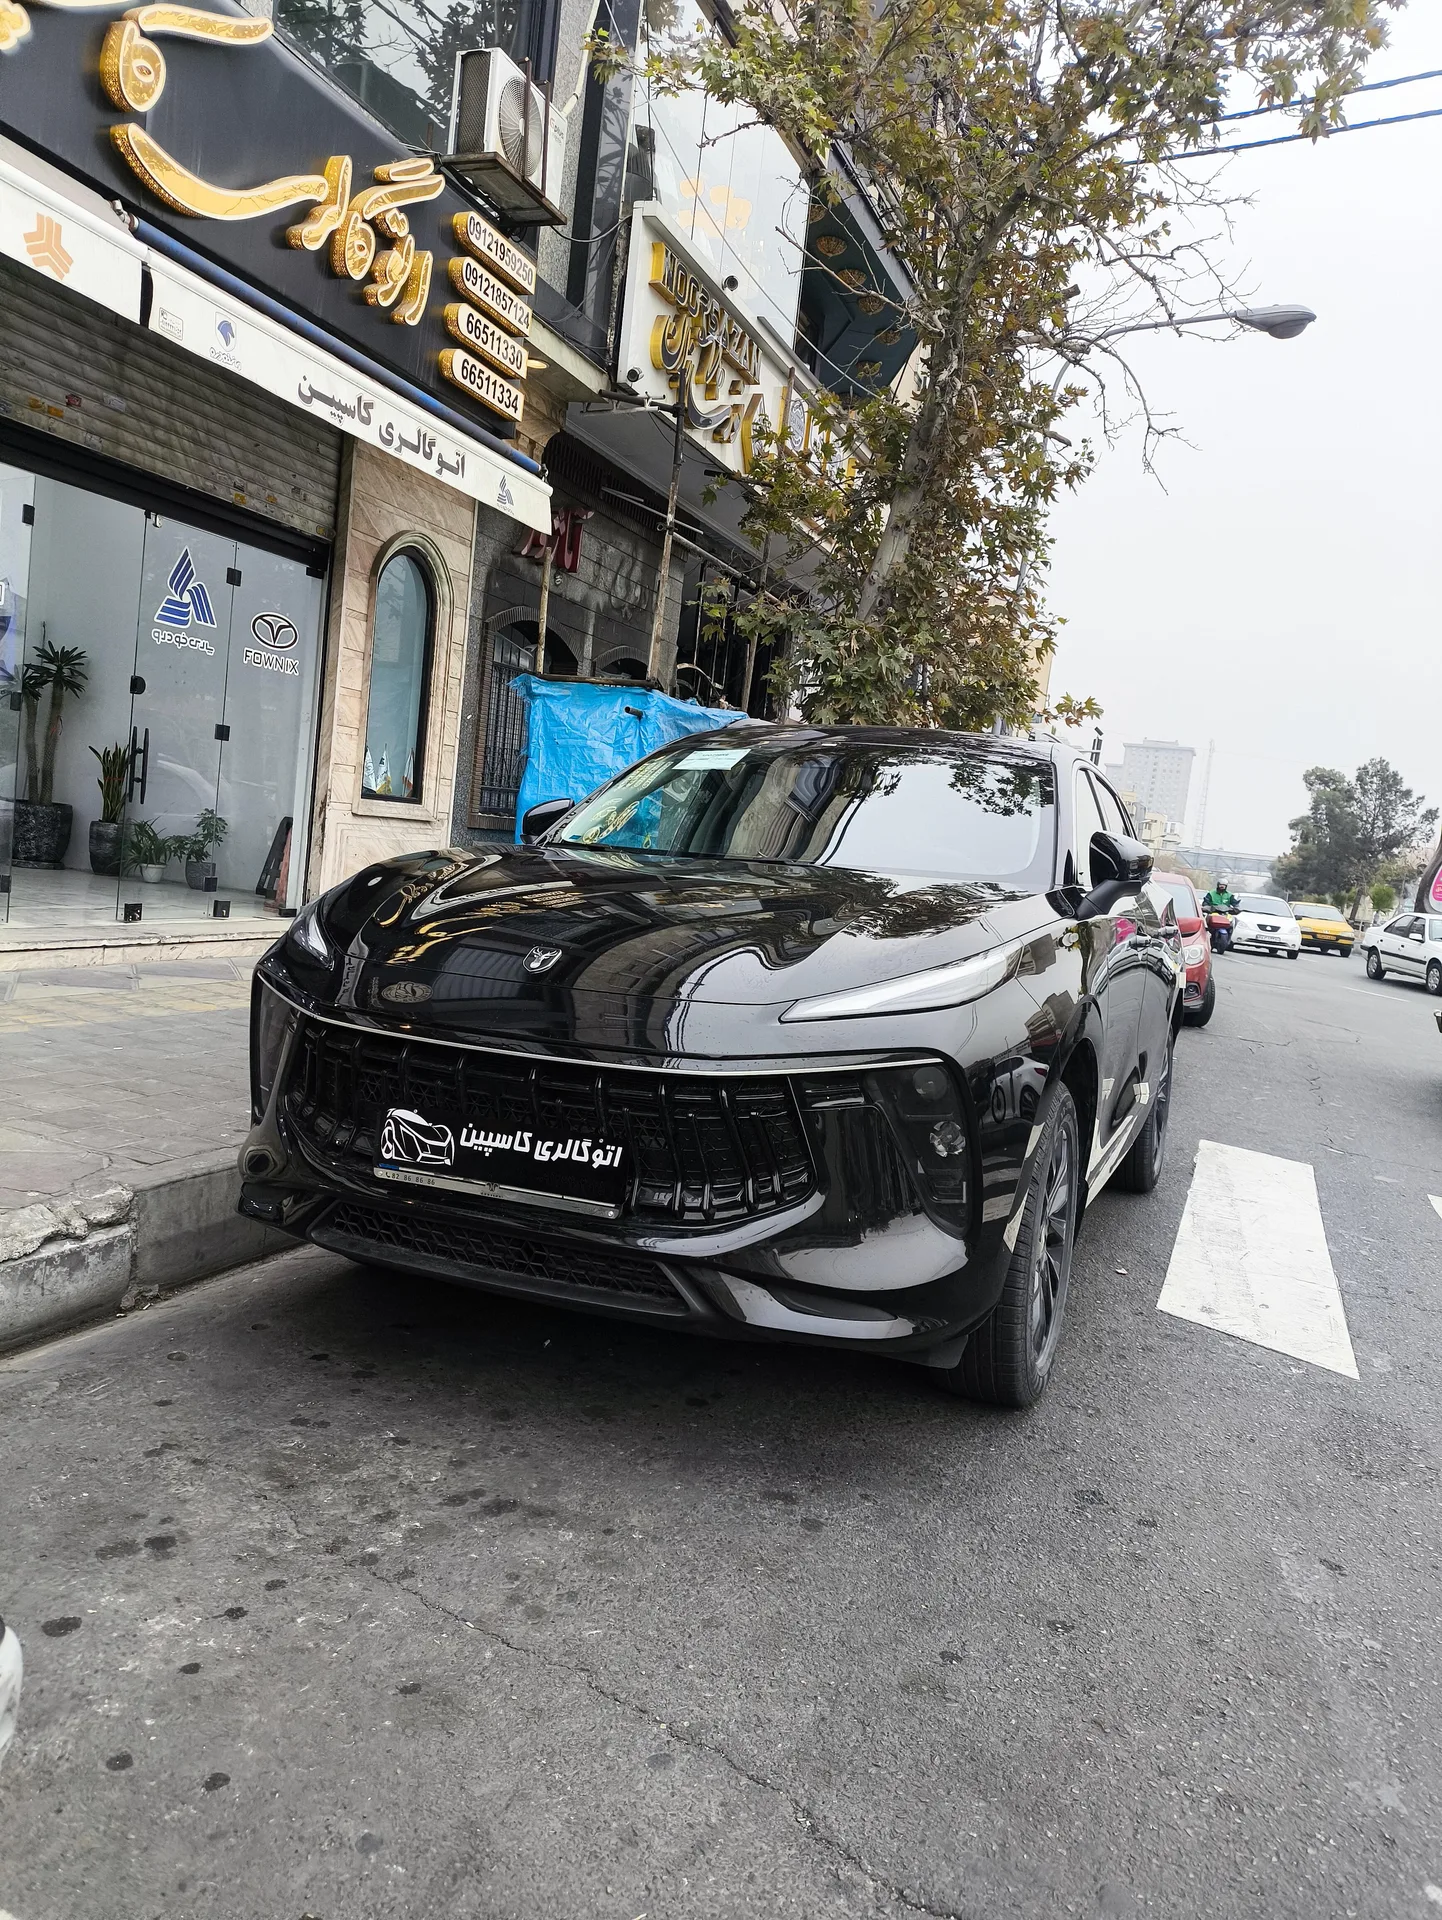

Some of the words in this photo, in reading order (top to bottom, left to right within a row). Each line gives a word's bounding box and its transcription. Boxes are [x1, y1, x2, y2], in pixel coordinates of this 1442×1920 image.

[468, 214, 534, 286] 09121959250
[464, 262, 530, 330] 09121857124
[466, 312, 523, 370] 66511330
[297, 374, 375, 426] کاسپین
[461, 358, 519, 414] 66511334
[244, 647, 299, 675] FOWNIX
[459, 1123, 533, 1157] کاسپین
